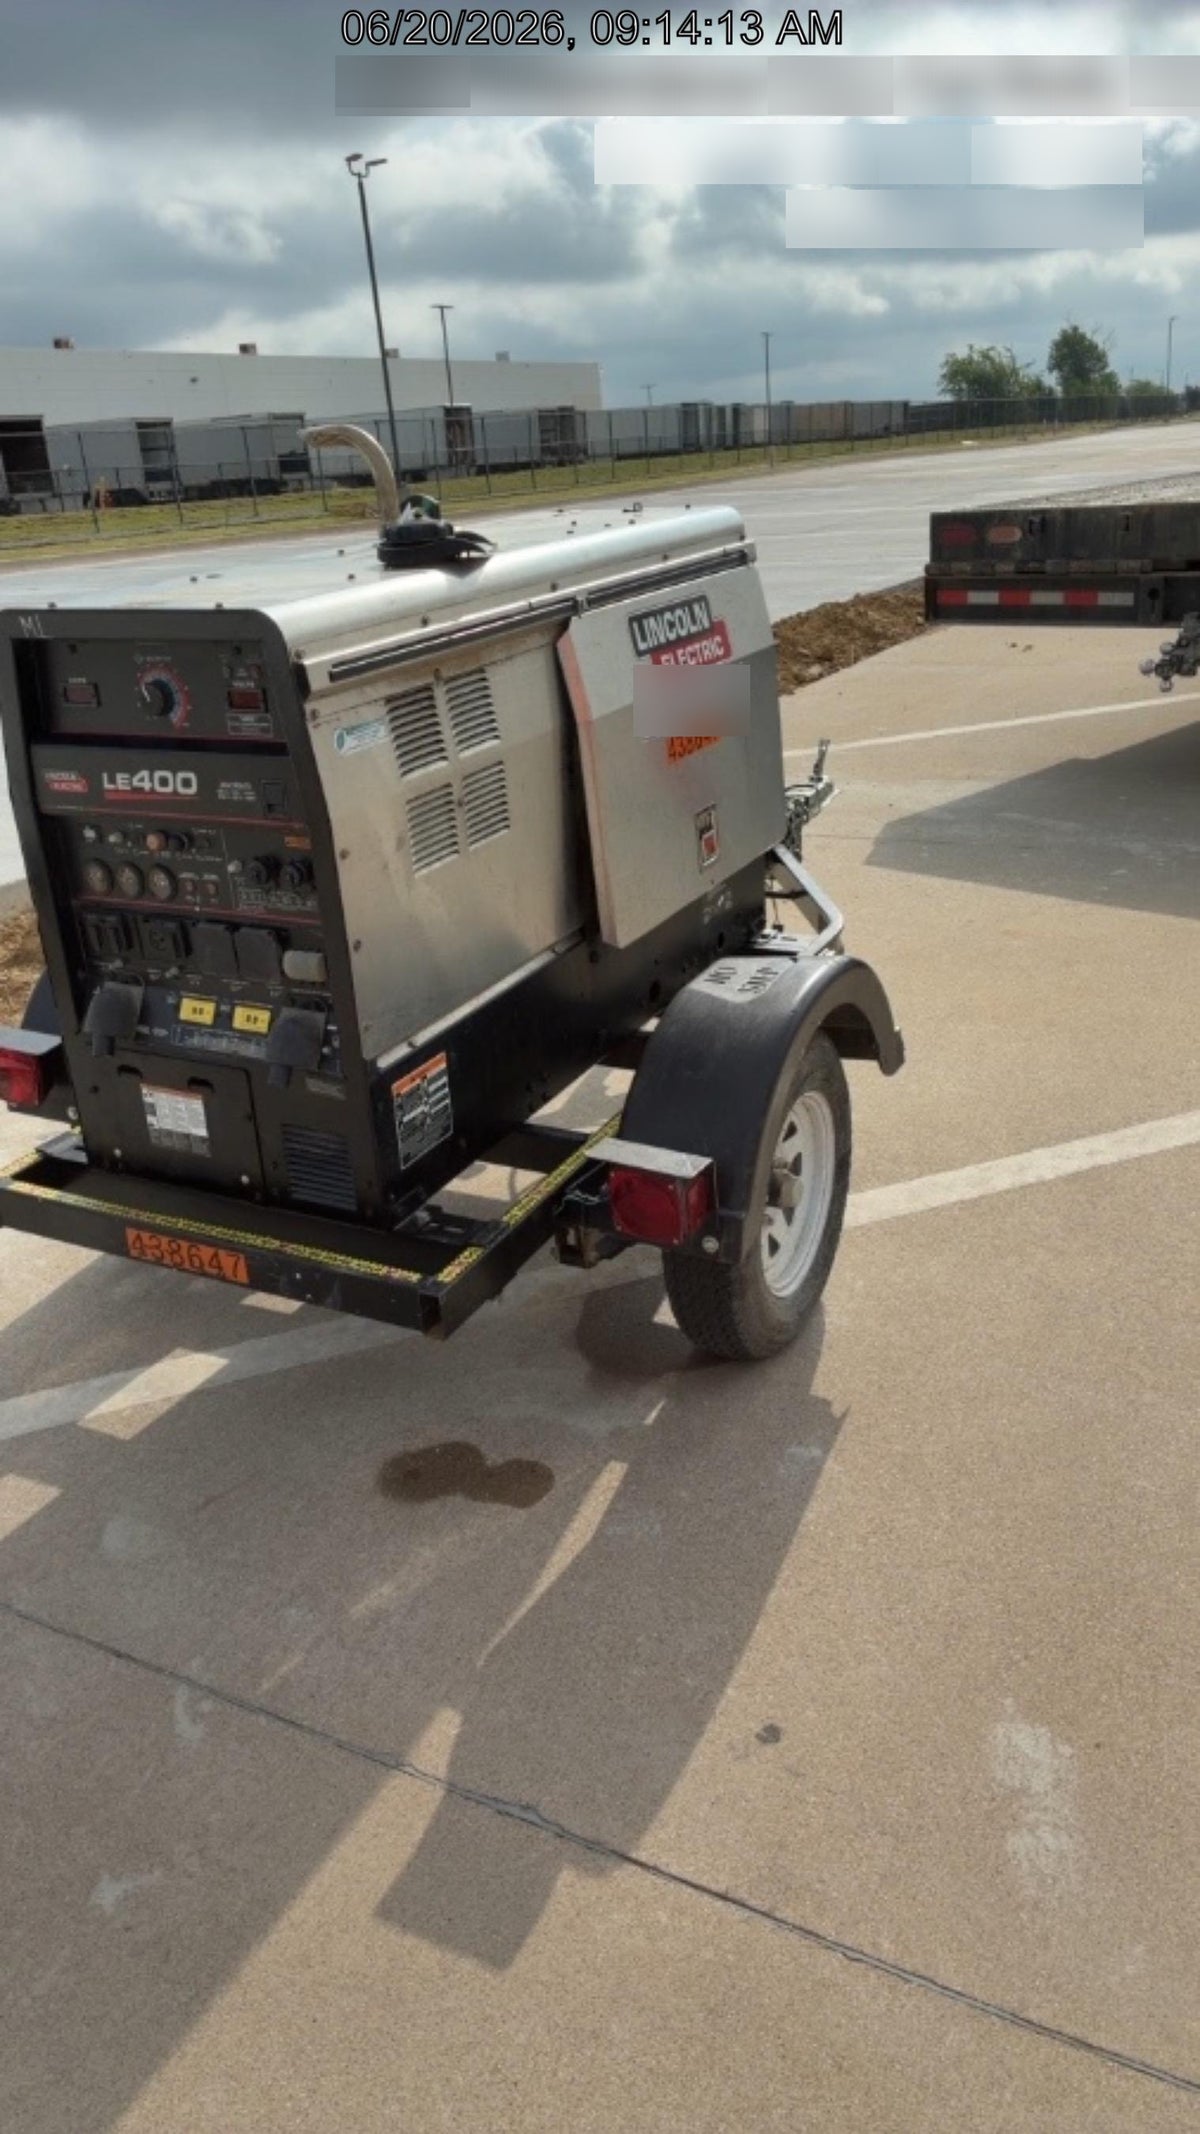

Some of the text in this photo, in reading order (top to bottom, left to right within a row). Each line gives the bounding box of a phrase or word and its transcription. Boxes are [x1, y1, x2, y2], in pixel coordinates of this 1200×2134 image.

[632, 601, 711, 649] LINCOLN
[660, 635, 724, 665] ELECTRIC
[102, 769, 198, 795] LE400
[131, 1232, 241, 1279] 438647
